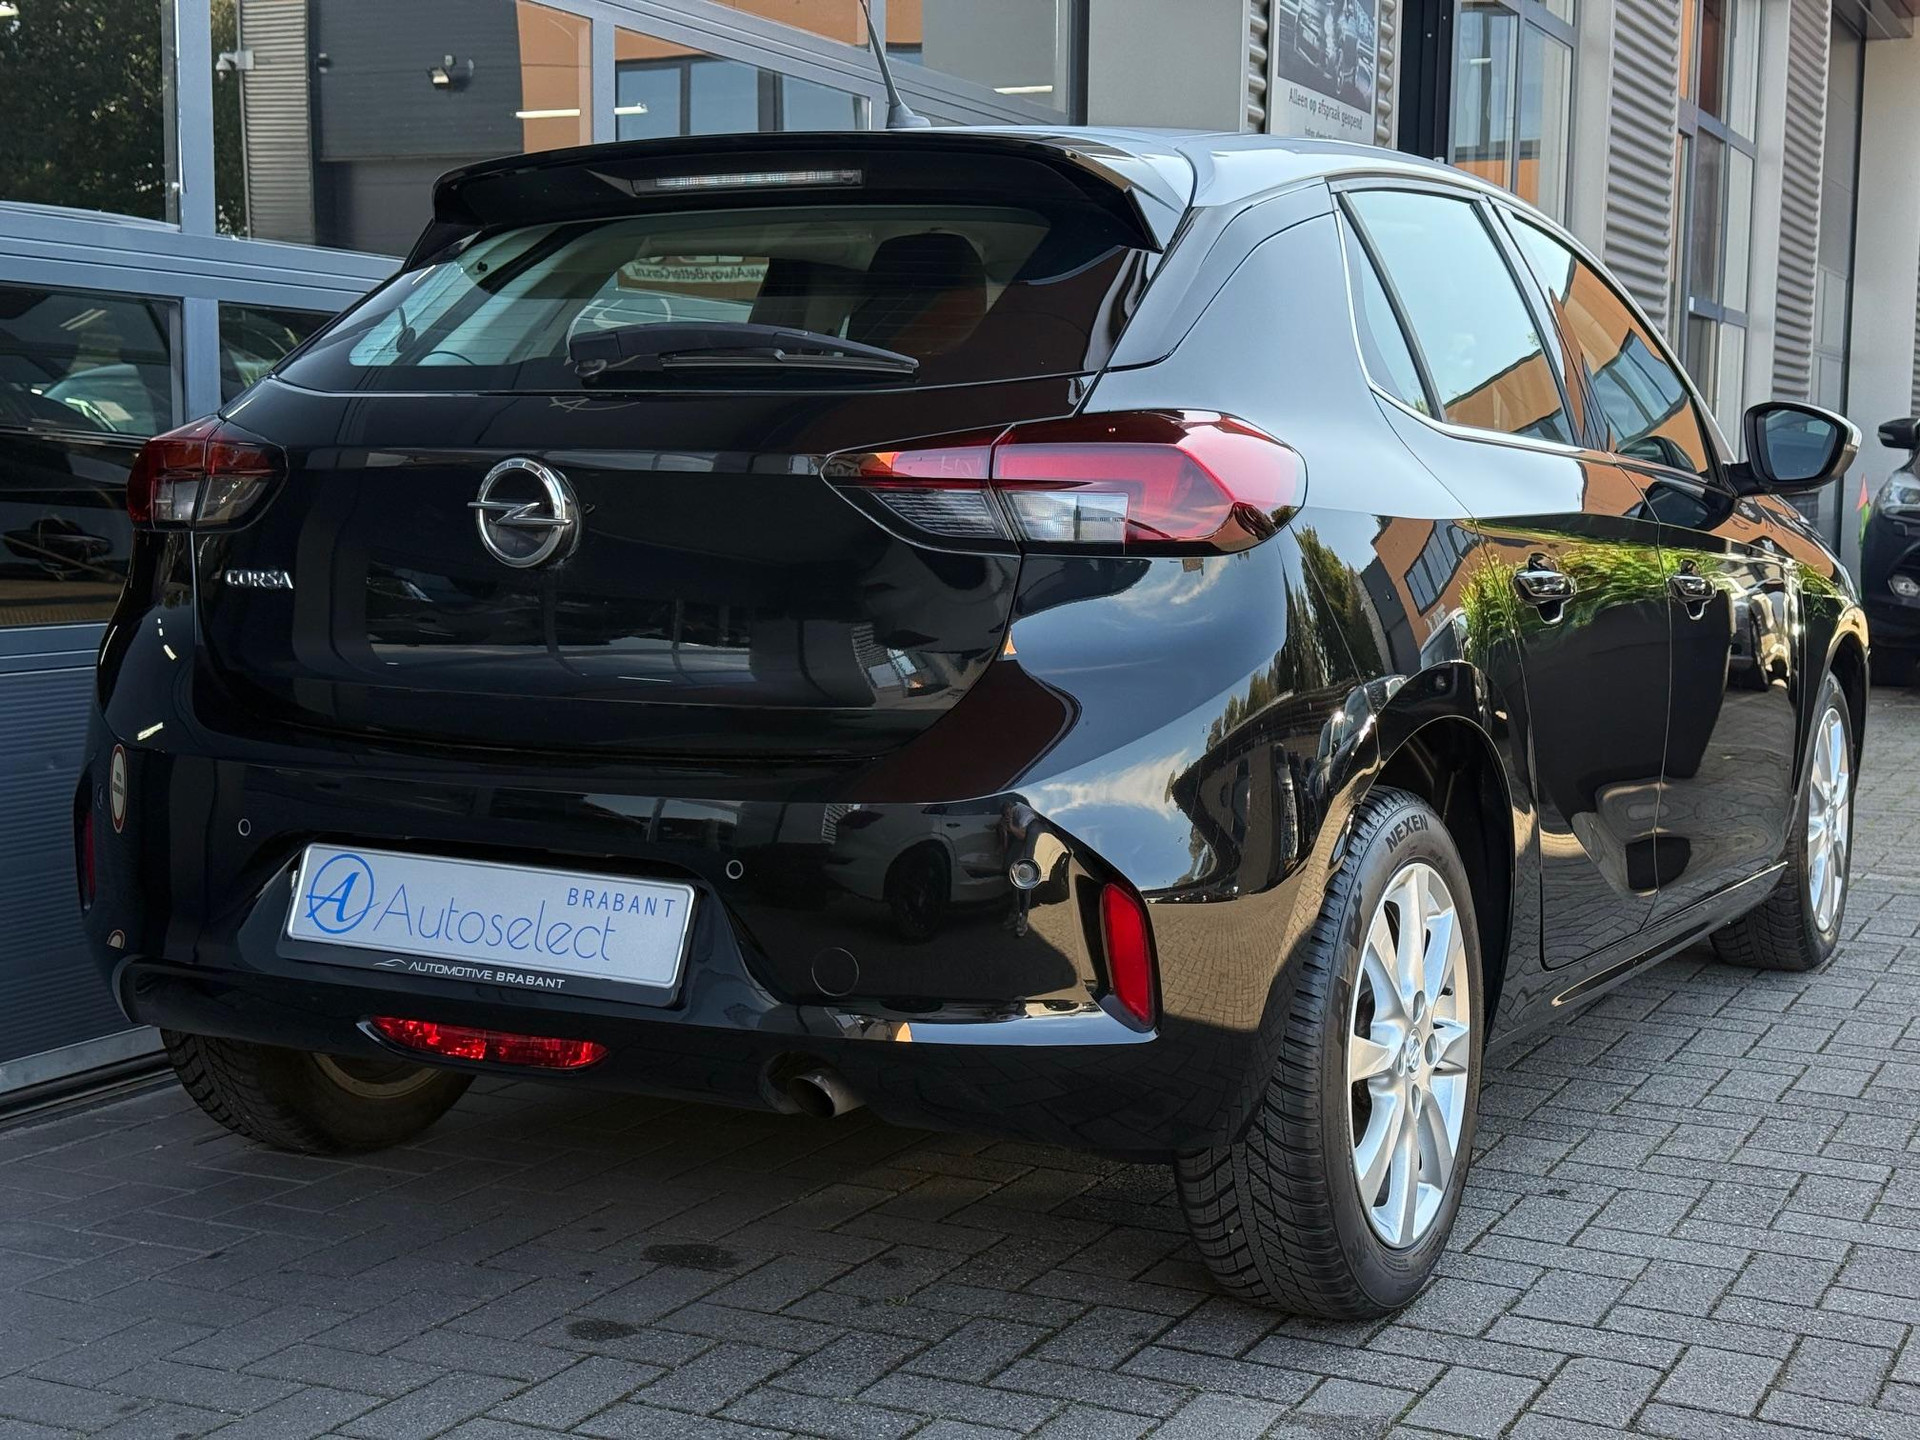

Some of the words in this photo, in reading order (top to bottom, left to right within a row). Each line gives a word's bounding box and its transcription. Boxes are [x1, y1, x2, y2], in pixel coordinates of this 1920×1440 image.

[1289, 87, 1308, 109] Alleen
[1309, 99, 1317, 115] op
[1318, 99, 1340, 120] afspraak
[1341, 111, 1363, 130] geopend
[225, 569, 294, 590] CORSA
[1385, 814, 1429, 853] NEXEN
[567, 887, 676, 918] BRABANT
[373, 883, 616, 962] Autoselect
[408, 961, 493, 980] AUTOMOTIVE
[496, 971, 566, 989] BRABANT
